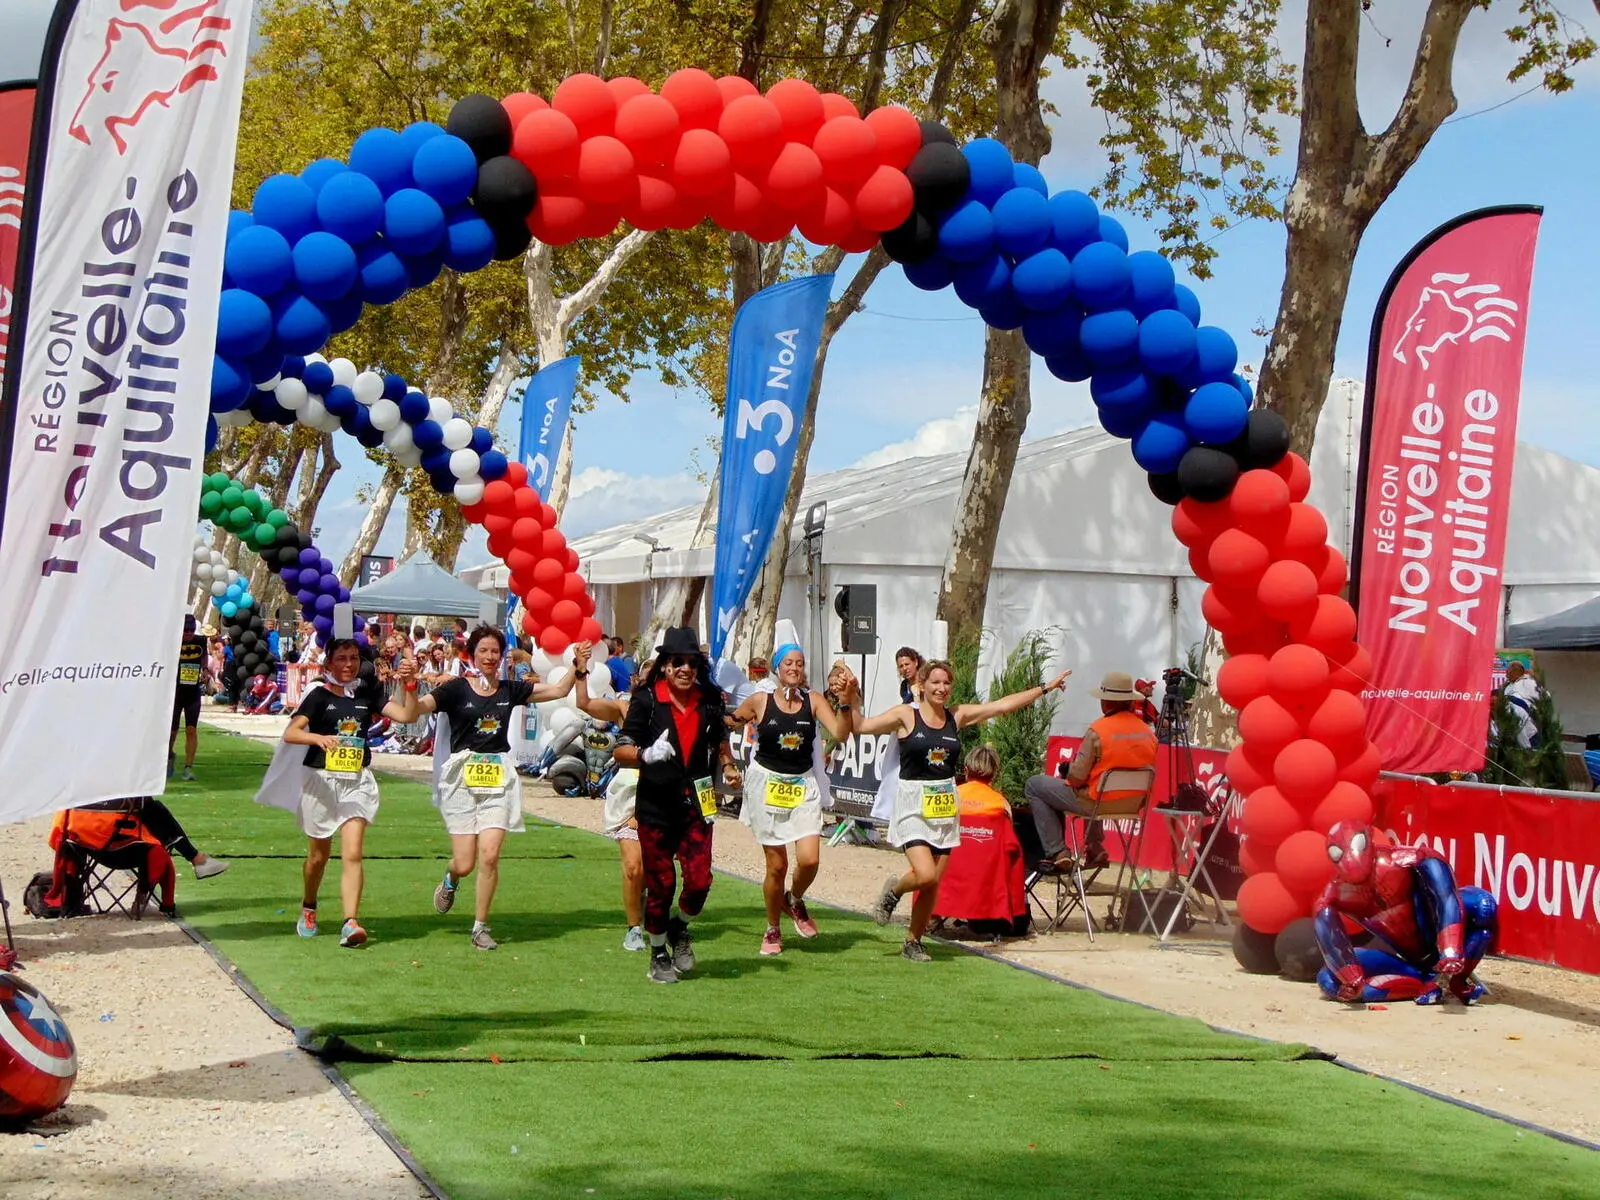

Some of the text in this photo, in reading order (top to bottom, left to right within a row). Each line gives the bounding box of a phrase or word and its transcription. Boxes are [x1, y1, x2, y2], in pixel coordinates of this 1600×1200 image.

[31, 310, 79, 452] RÉGION
[1371, 464, 1400, 555] RÉGION
[1388, 381, 1445, 633] Nouvelle-
[1438, 388, 1499, 635] Aquitaine
[1361, 688, 1484, 703] nouvelle-aquitaine.fr
[467, 764, 500, 775] 7821
[769, 783, 802, 797] 7846
[925, 794, 955, 806] 7833
[1473, 832, 1600, 925] Nouv
